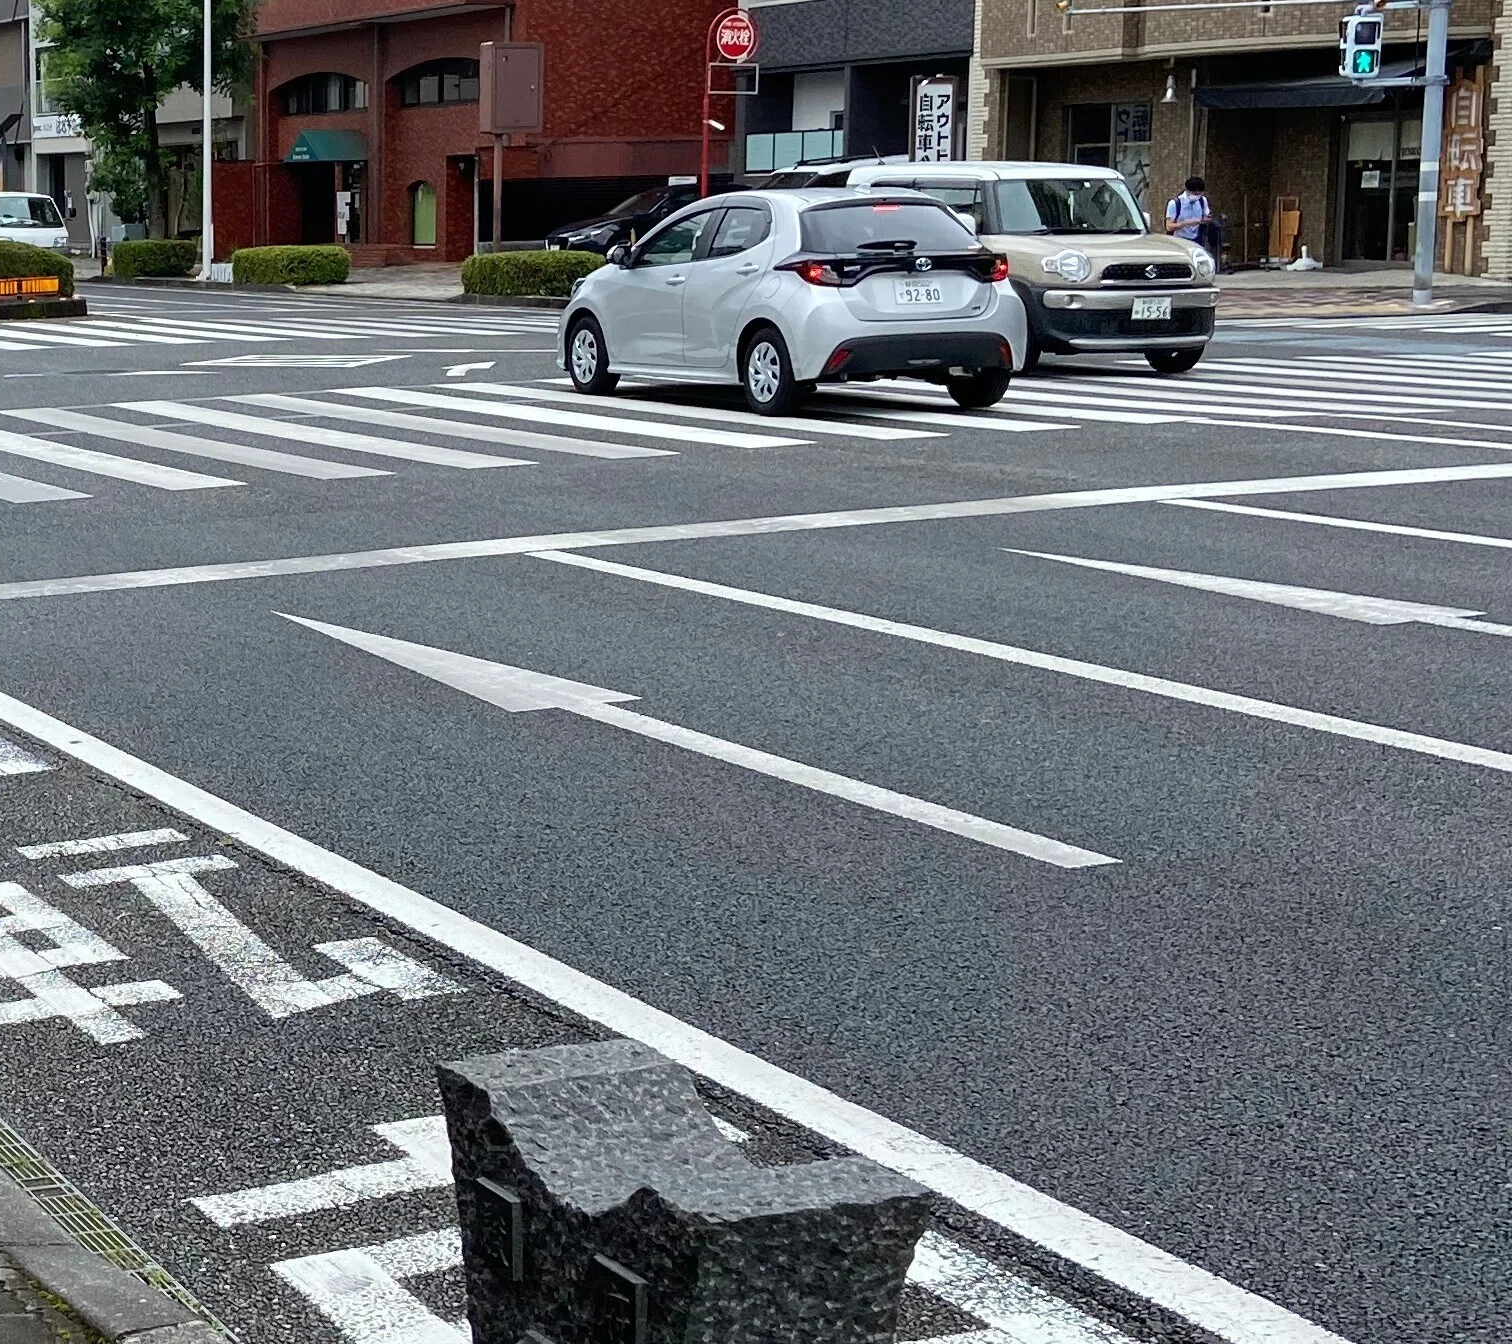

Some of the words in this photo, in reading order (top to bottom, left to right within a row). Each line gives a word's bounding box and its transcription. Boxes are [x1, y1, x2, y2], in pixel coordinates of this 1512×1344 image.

[720, 28, 751, 46] 消火栓
[1445, 84, 1478, 218] 自転車
